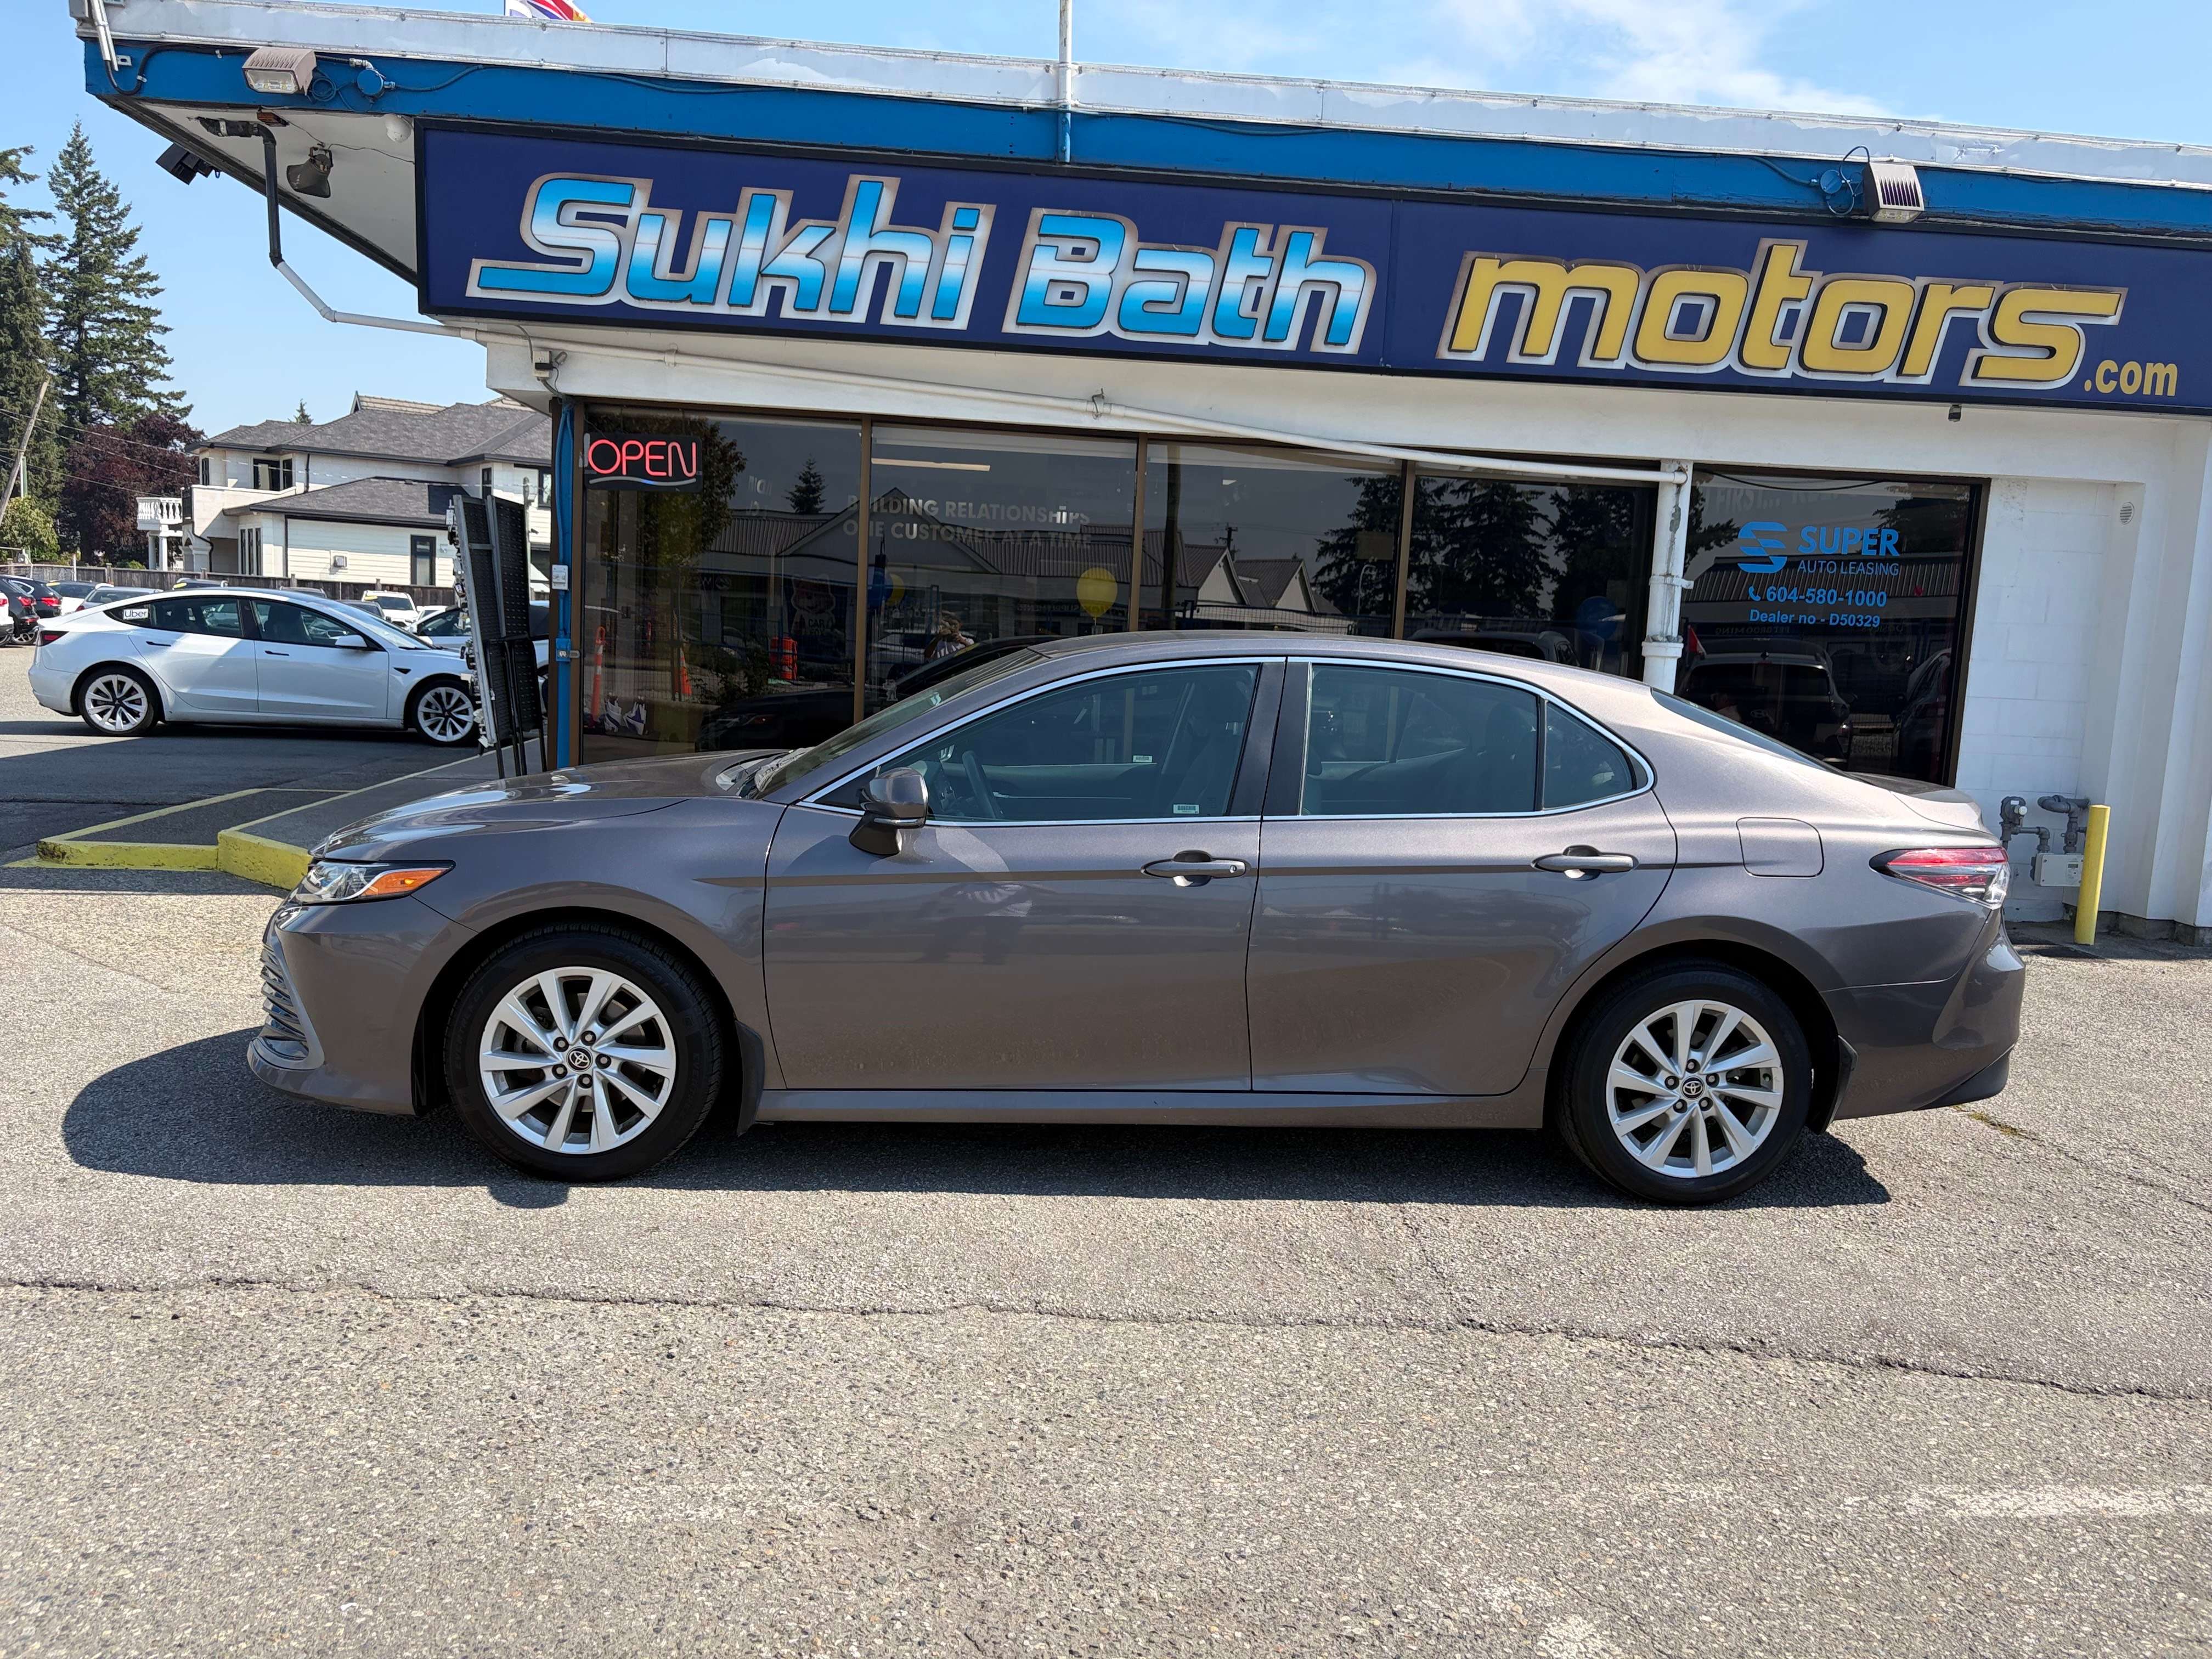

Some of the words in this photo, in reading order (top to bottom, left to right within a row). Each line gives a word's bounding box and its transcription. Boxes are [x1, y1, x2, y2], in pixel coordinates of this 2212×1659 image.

[465, 172, 996, 329] Sukhi
[1002, 207, 1376, 355] Bath
[1435, 238, 2129, 390] motors
[2084, 360, 2177, 397] .com
[588, 439, 696, 477] OPEN
[945, 501, 1090, 525] RELATIONSHIPS
[891, 522, 995, 542] CUSTOMER
[1798, 526, 1900, 556] SUPER
[1797, 560, 1836, 574] AUTO
[1841, 561, 1899, 575] LEASING
[1766, 586, 1887, 607] 604-580-1000
[1750, 610, 1795, 623] Dealer
[1798, 614, 1816, 624] no
[1829, 613, 1880, 628] D50329
